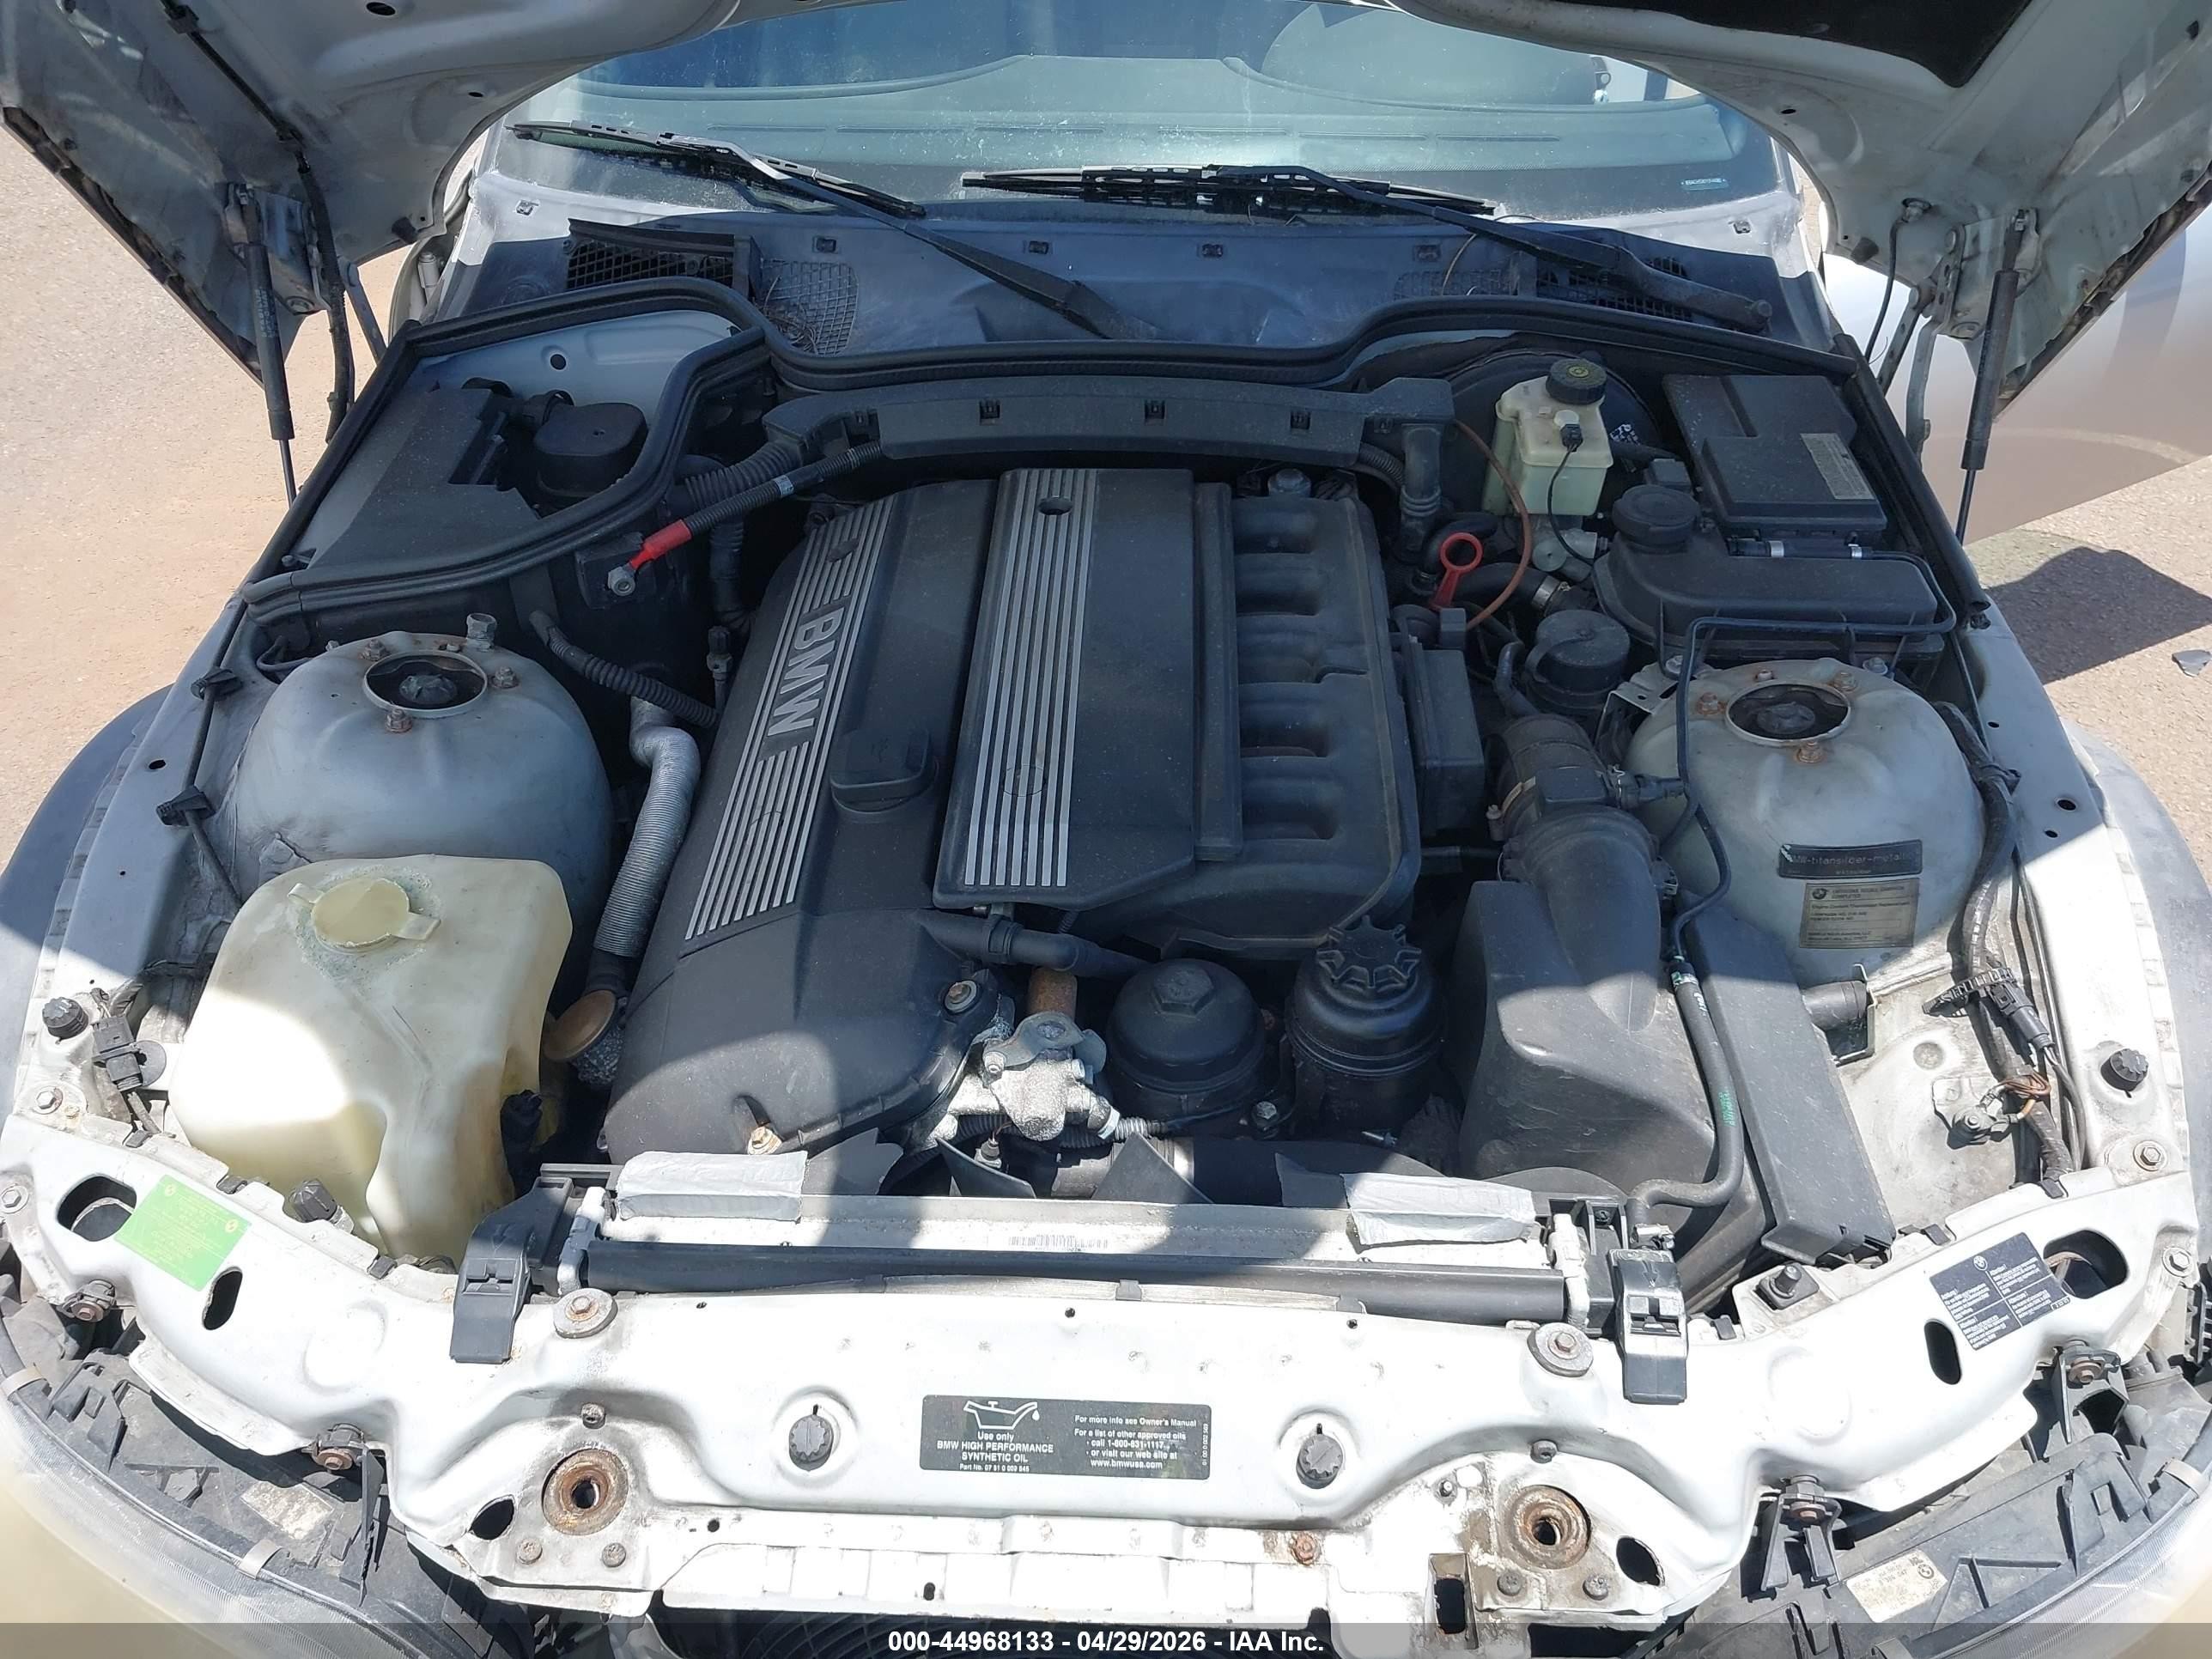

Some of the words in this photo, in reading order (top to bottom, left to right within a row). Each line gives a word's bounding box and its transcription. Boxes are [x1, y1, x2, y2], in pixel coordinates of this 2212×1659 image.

[767, 606, 845, 736] BMW
[1074, 1414, 1088, 1423] For
[1089, 1416, 1108, 1425] more
[1139, 1417, 1170, 1425] Owner's
[1170, 1418, 1197, 1427] Manual
[977, 1430, 994, 1441] Use
[996, 1431, 1014, 1443] only
[1074, 1428, 1087, 1437] For
[1094, 1429, 1106, 1437] list
[1107, 1429, 1115, 1437] of
[1116, 1430, 1136, 1438] other
[1137, 1431, 1171, 1440] approved
[1172, 1431, 1187, 1440] oils
[937, 1440, 960, 1450] BMW
[961, 1440, 984, 1451] HIGH
[985, 1442, 1054, 1454] PERFORMANCE
[1091, 1438, 1105, 1447] call
[962, 1451, 1012, 1463] SYNTHETIC
[1013, 1453, 1029, 1464] OIL
[1101, 1449, 1118, 1458] visit
[1135, 1450, 1152, 1459] web
[1170, 1451, 1177, 1460] at
[959, 1462, 972, 1471] Part
[1091, 1458, 1164, 1470] www.bmwusa.com
